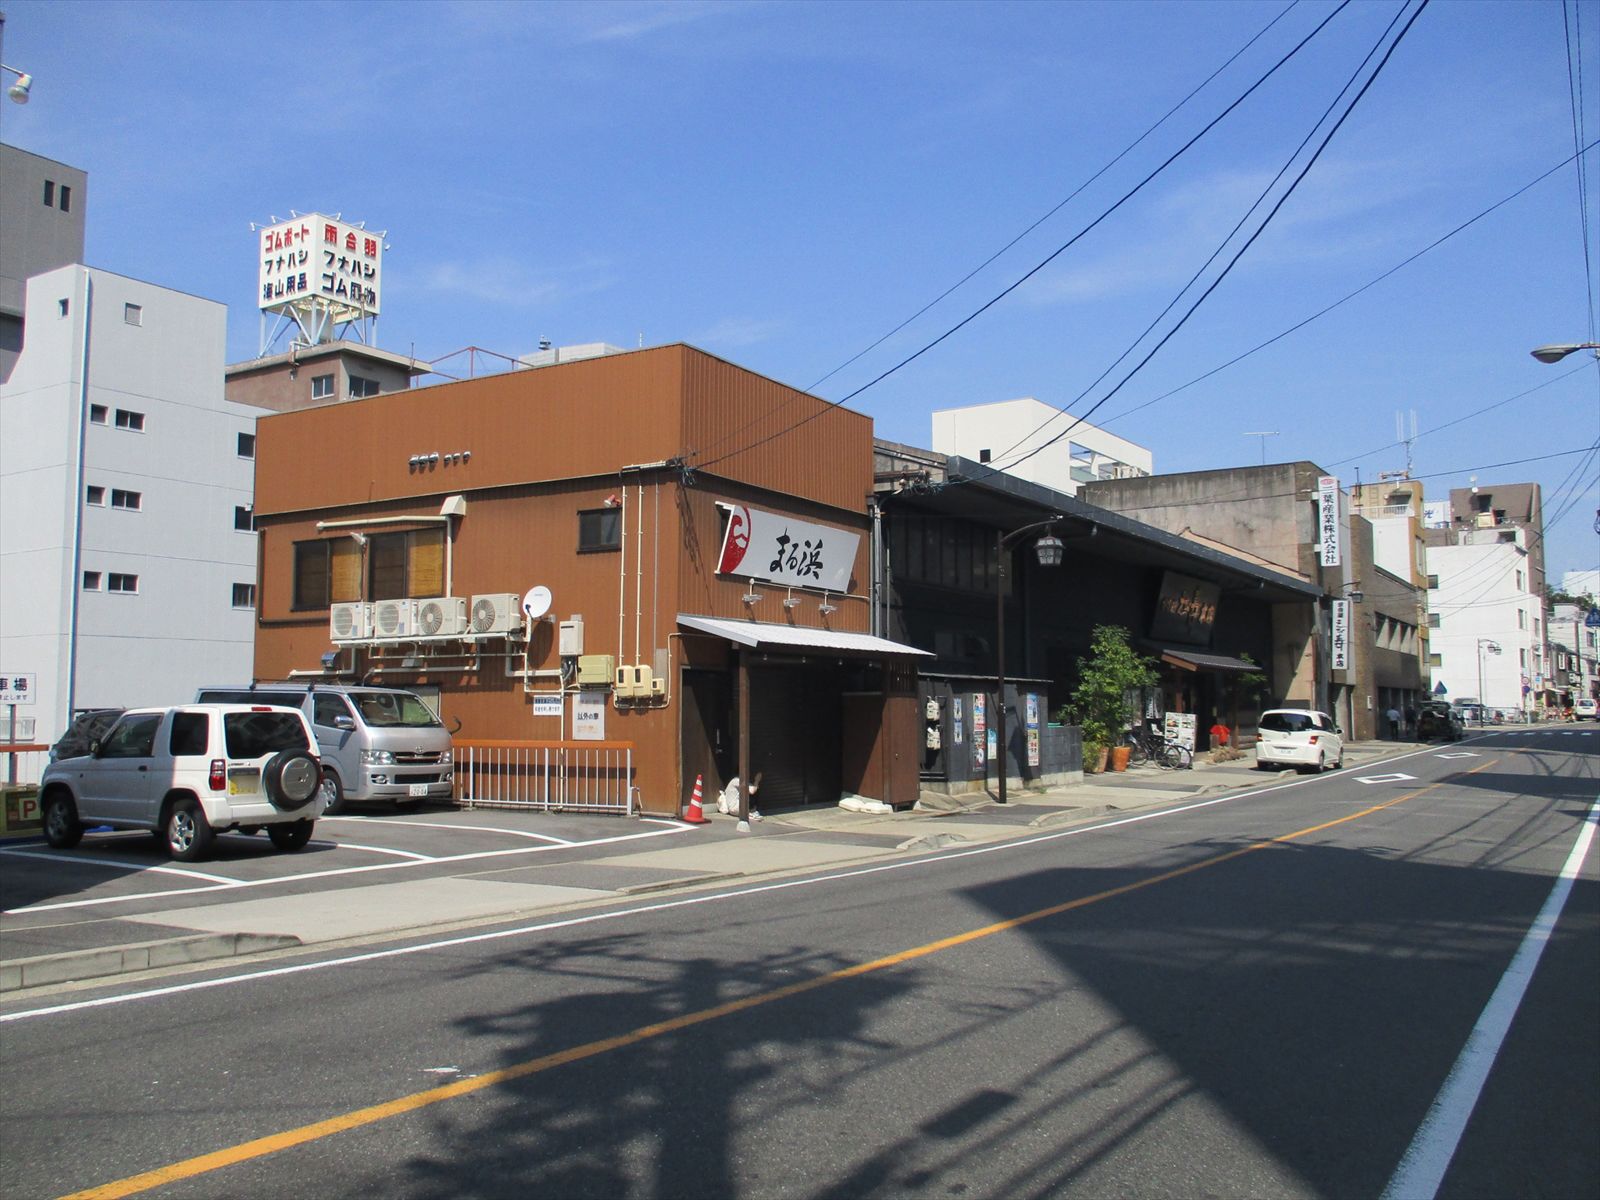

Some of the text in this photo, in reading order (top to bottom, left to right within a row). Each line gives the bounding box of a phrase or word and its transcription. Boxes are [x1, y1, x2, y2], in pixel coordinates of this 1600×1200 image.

[265, 224, 310, 253] ゴムボート
[324, 223, 377, 259] 雨合羽
[265, 249, 308, 275] フナハシ
[323, 249, 376, 278] フナハシ
[263, 272, 308, 301] 海山用品
[769, 527, 824, 580] まる浜
[23, 799, 37, 819] P
